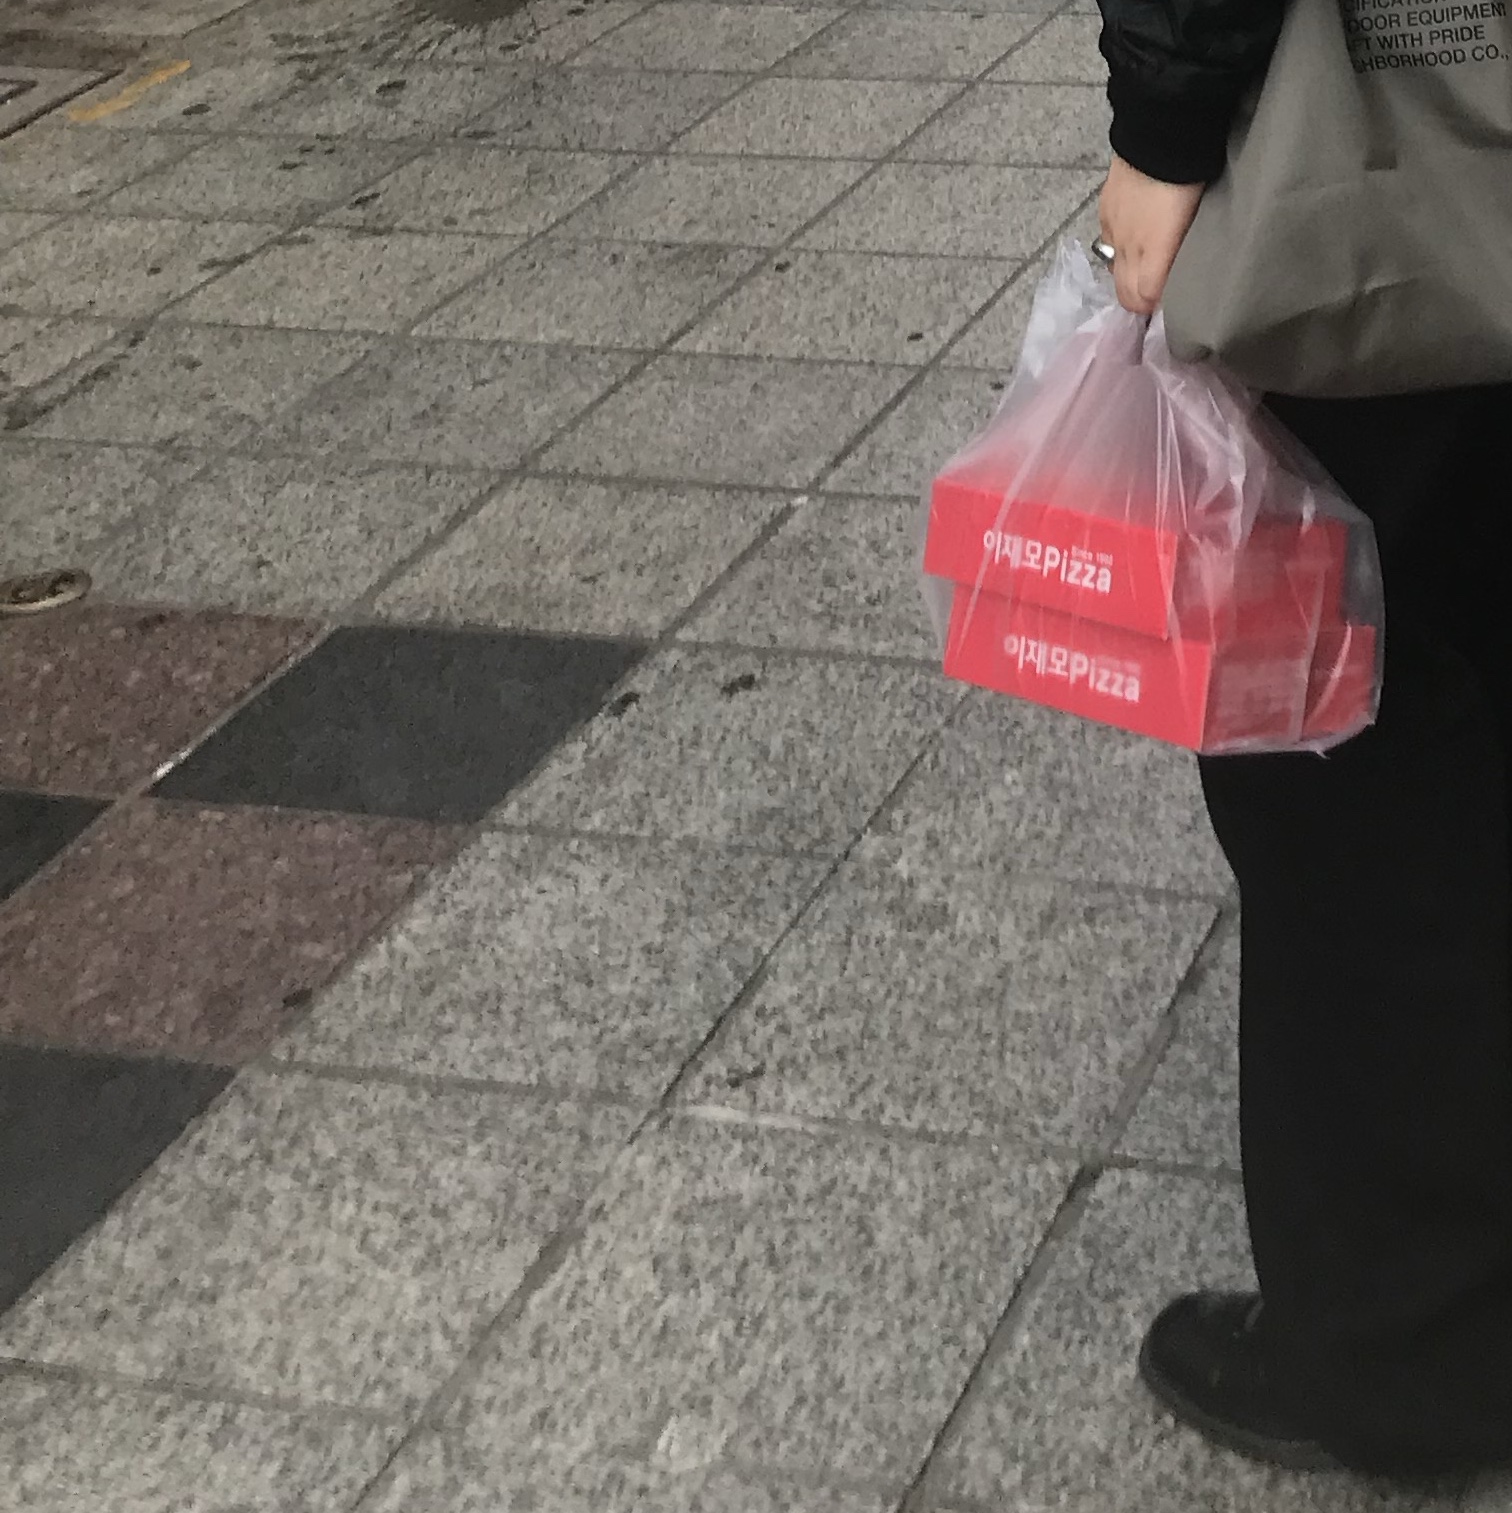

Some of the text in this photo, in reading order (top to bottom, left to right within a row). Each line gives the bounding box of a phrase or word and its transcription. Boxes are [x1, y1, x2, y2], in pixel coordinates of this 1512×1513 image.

[1377, 31, 1424, 51] WITH
[1429, 24, 1486, 46] PRIDE
[1471, 43, 1510, 62] CO.,
